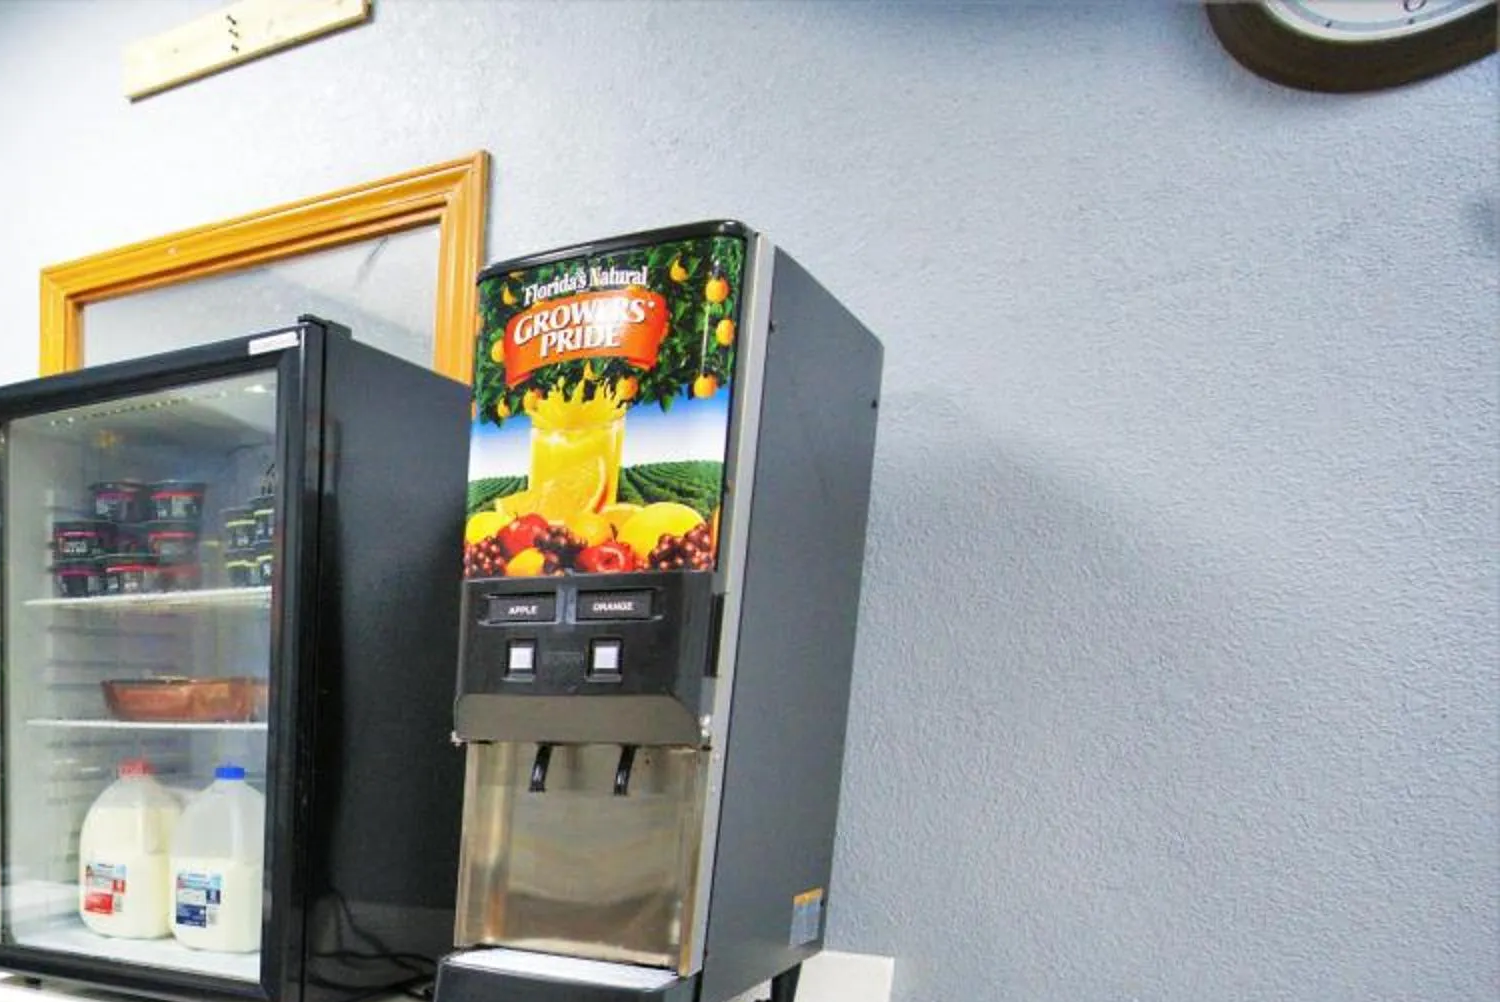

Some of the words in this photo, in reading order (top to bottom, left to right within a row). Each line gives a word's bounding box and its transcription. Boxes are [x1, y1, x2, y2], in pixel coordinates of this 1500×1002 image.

[522, 269, 587, 306] Florida's
[589, 265, 648, 287] Natural
[512, 297, 646, 346] GROWRS
[539, 323, 621, 358] PRIDE
[508, 605, 538, 615] APPLE
[592, 601, 635, 613] ORANGE
